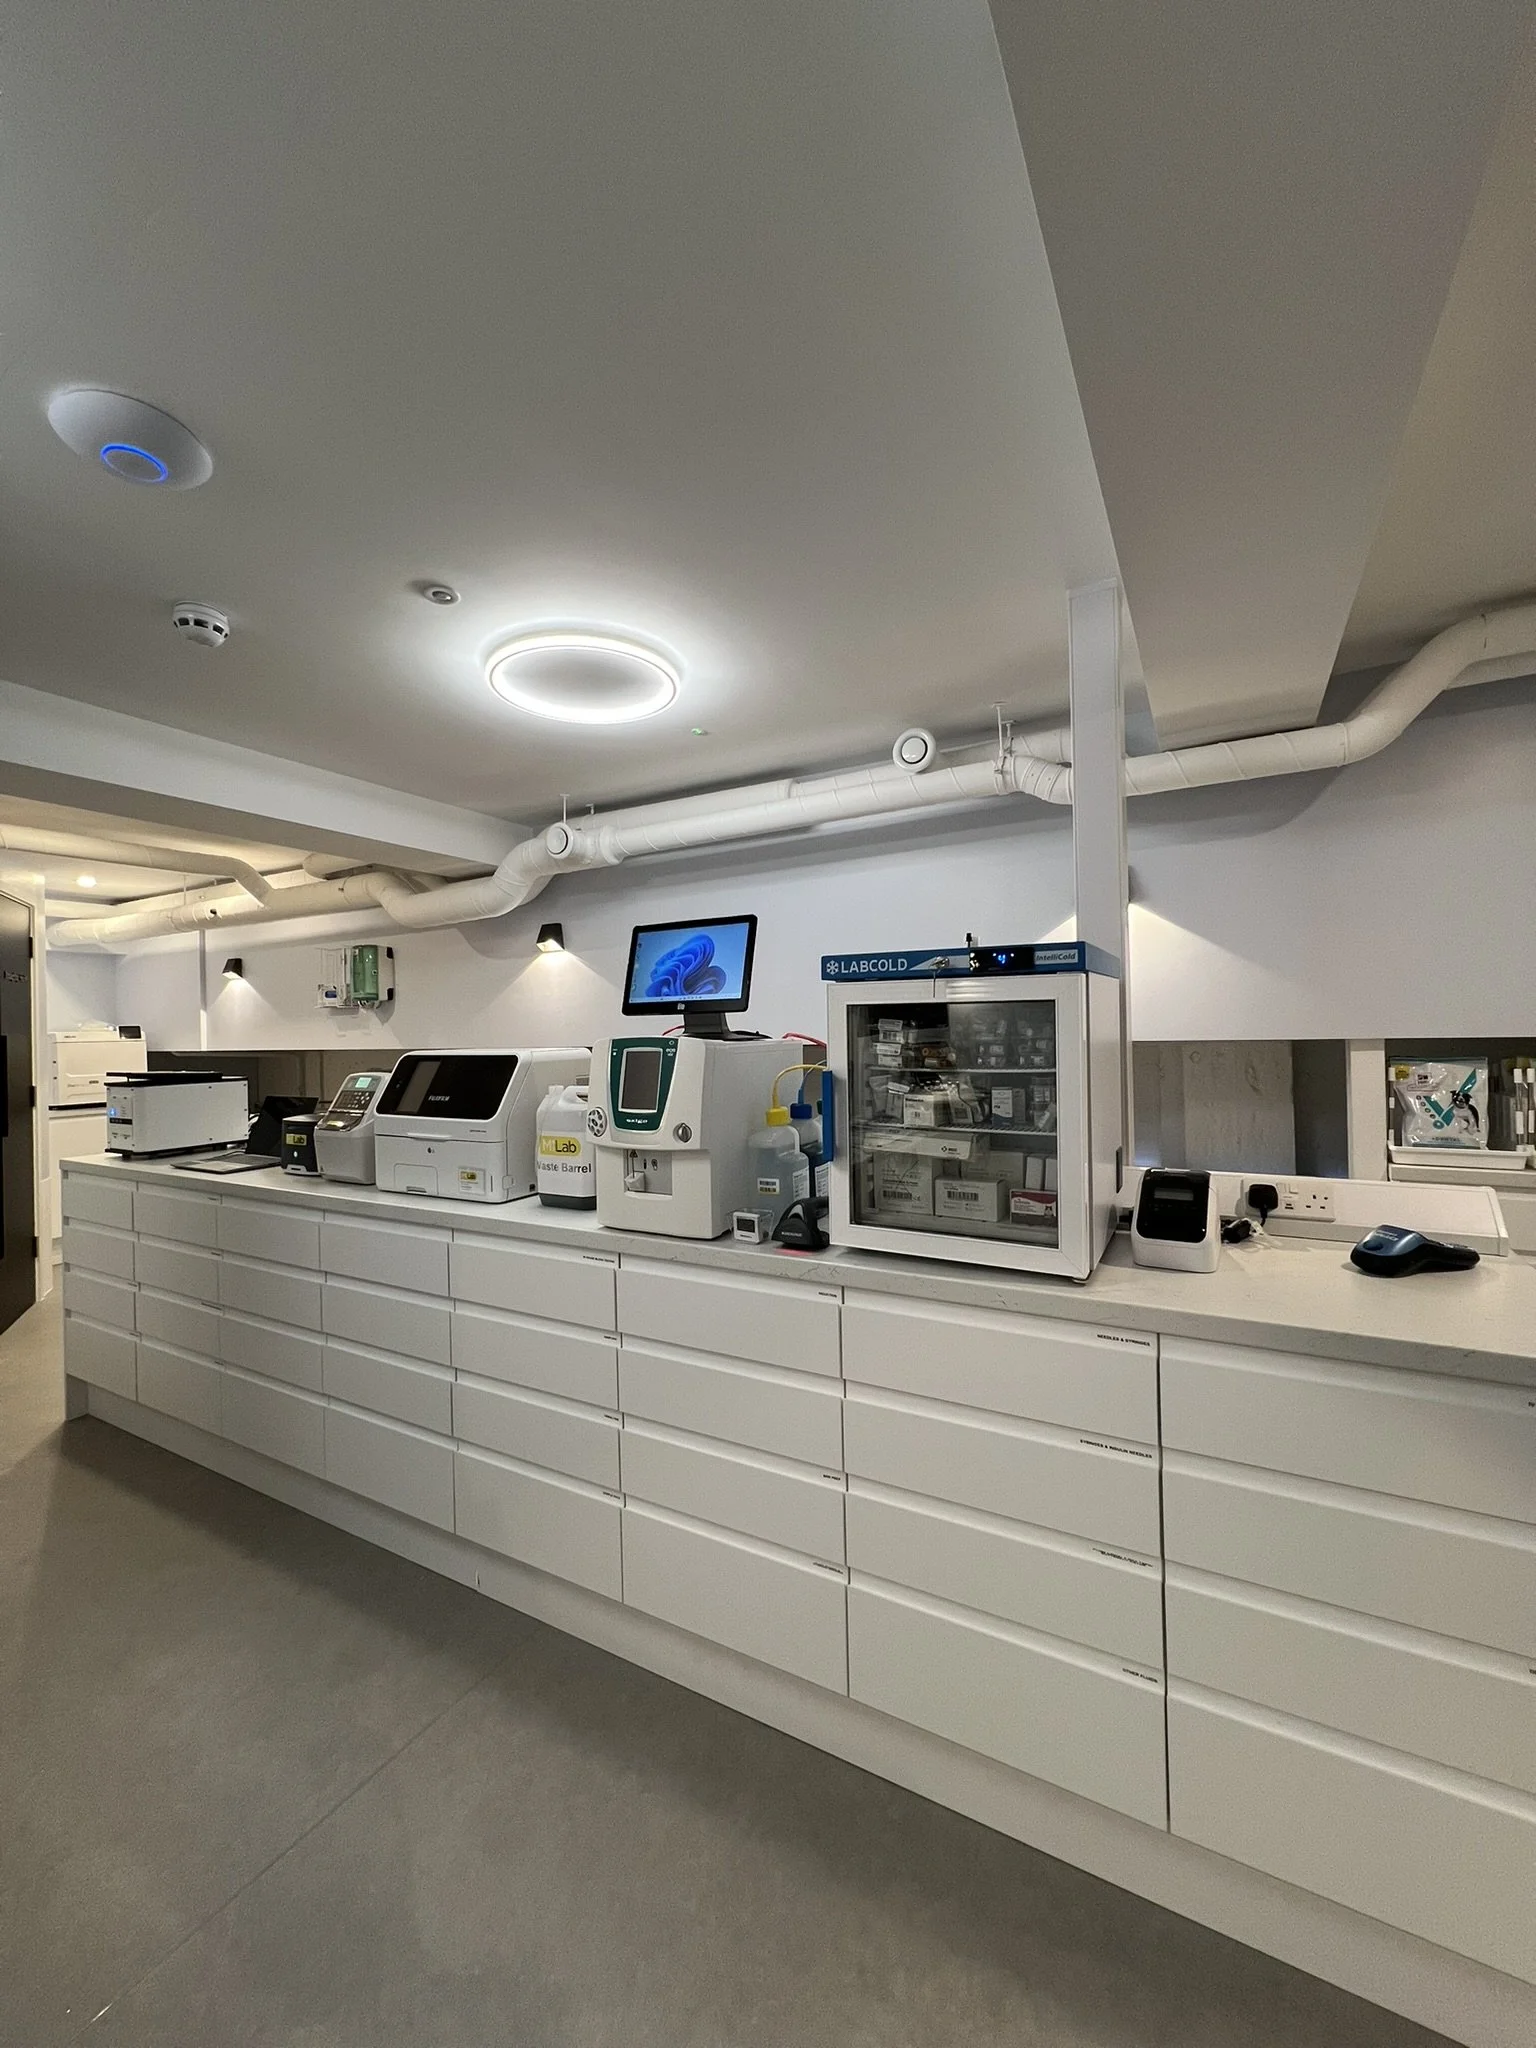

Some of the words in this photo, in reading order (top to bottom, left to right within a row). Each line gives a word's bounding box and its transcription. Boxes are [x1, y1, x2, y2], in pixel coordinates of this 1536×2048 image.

[1036, 953, 1076, 961] IntelliCold
[841, 958, 908, 974] LABCOLD
[561, 1162, 592, 1173] Barrel
[1097, 1334, 1120, 1342] NEEDLES
